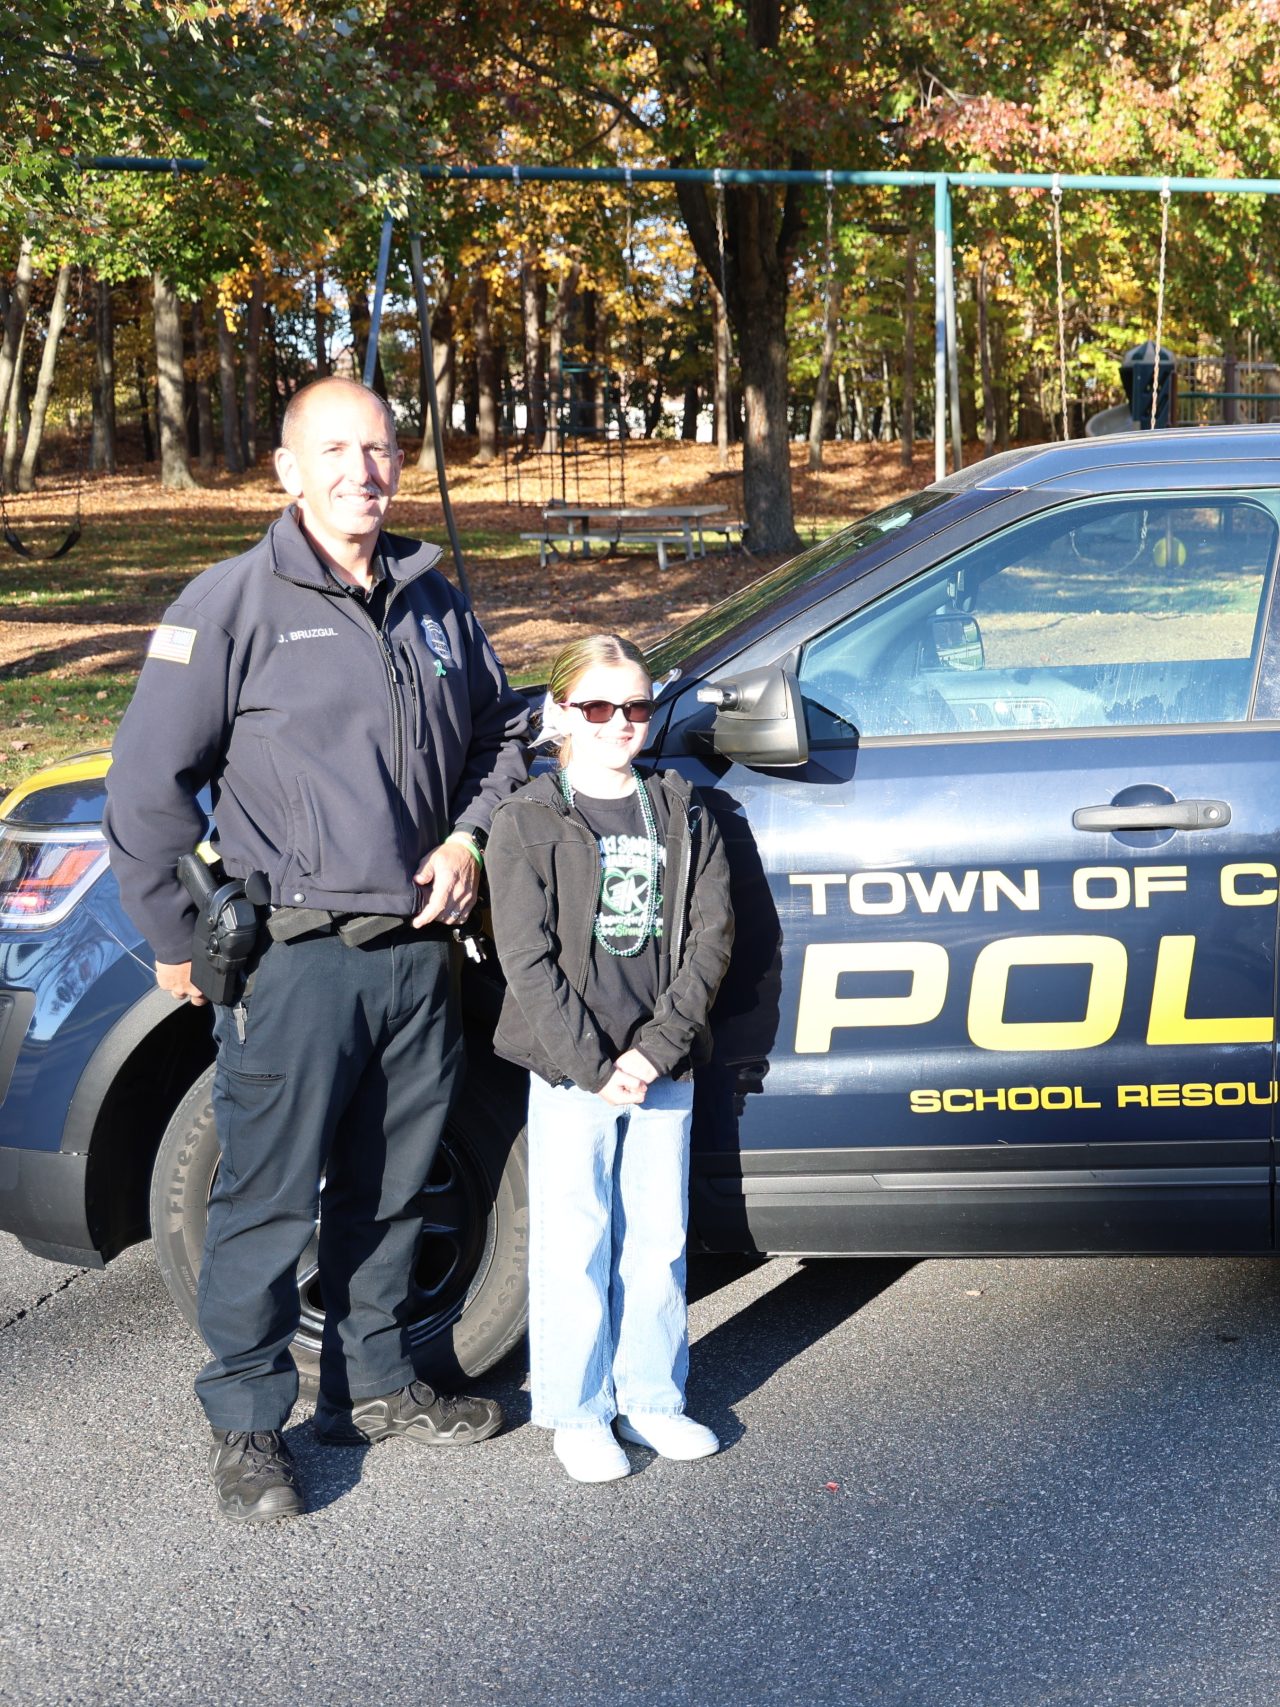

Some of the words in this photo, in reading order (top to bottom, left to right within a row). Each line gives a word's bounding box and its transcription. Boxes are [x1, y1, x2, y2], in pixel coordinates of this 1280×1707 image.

[278, 634, 289, 643] J.
[290, 627, 339, 641] BRUZGUL
[788, 869, 1040, 916] TOWN
[1072, 865, 1188, 910] OF
[909, 1086, 1101, 1113] SCHOOL
[167, 1102, 215, 1217] Firesto
